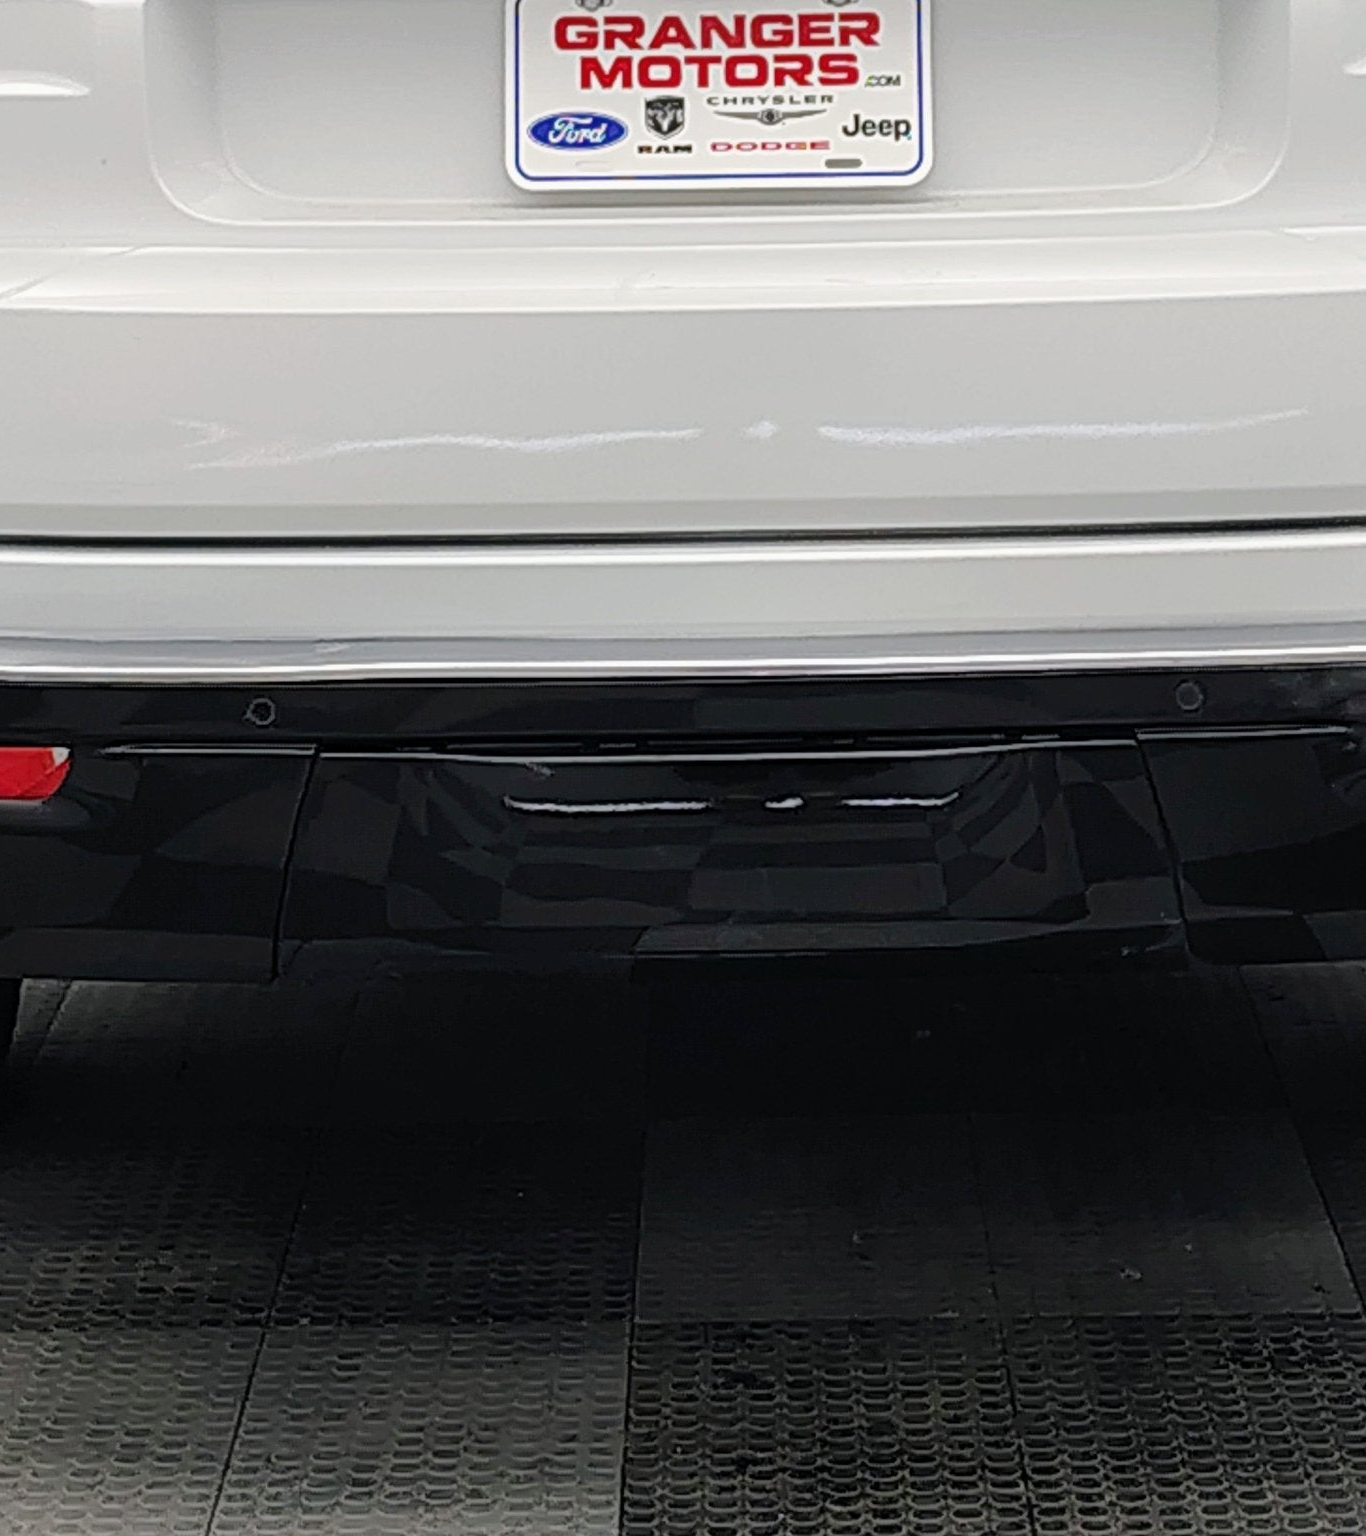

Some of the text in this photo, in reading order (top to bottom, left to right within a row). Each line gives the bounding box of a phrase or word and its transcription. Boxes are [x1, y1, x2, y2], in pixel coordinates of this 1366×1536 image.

[554, 12, 881, 51] GRANGER
[579, 53, 860, 90] MOTORS
[706, 94, 834, 106] CHRYSLER
[548, 116, 607, 143] Ford
[842, 114, 912, 143] Jeep
[637, 143, 693, 154] RAM
[710, 141, 831, 152] DODGE
